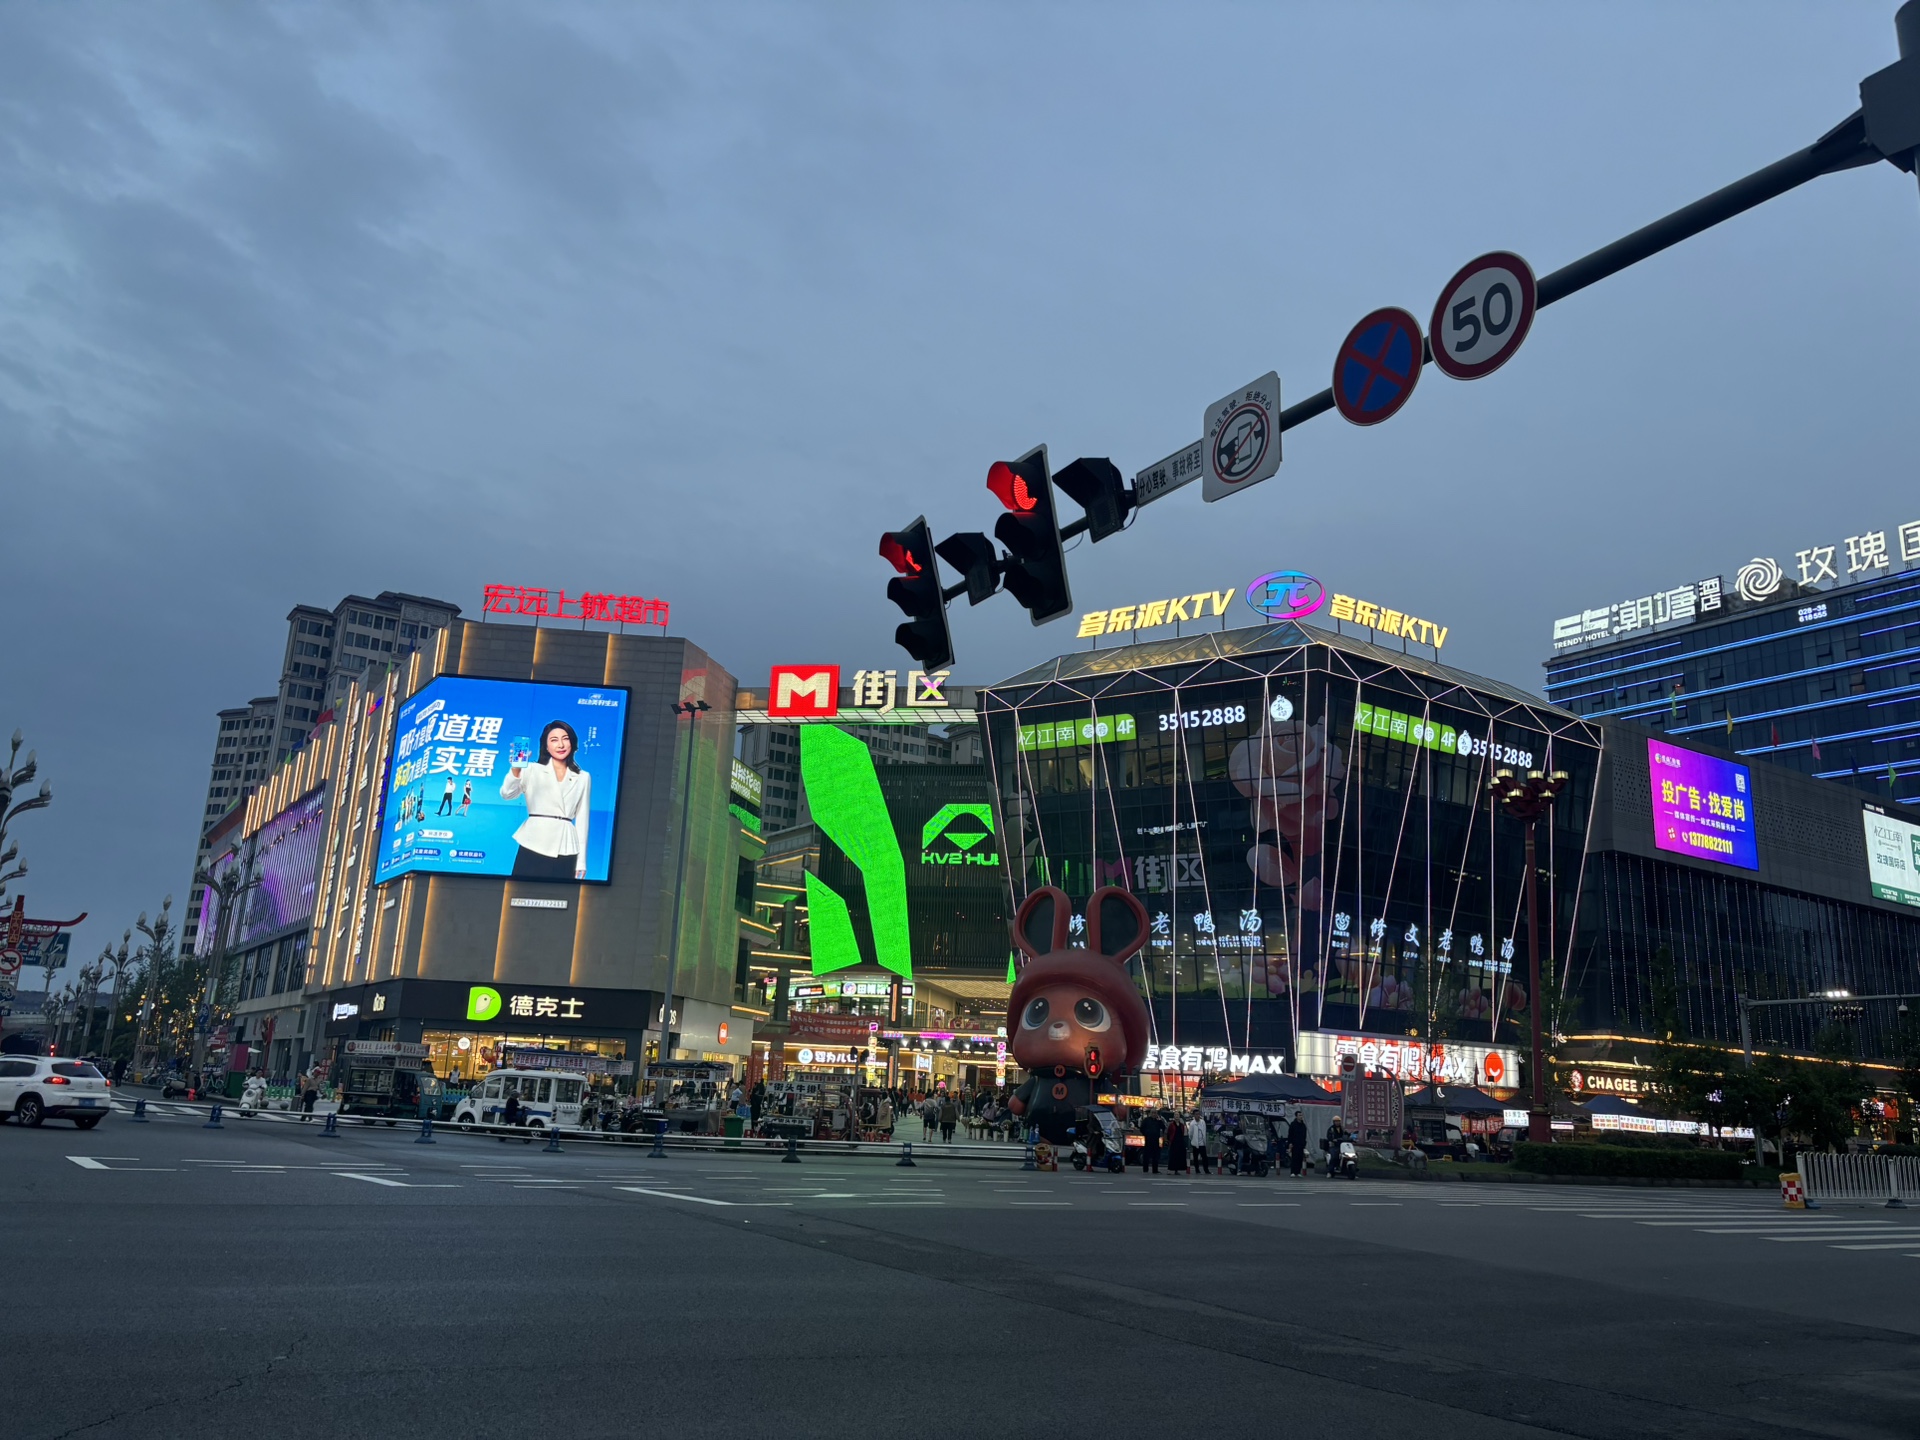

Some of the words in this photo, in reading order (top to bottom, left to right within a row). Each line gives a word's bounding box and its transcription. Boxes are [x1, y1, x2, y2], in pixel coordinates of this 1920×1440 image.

[1452, 282, 1513, 352] 50
[1077, 588, 1236, 638] 音乐派KTV
[1329, 593, 1449, 649] 音乐派KTV
[1799, 611, 1828, 623] 618555
[1553, 637, 1584, 650] TRENDY
[1585, 631, 1611, 641] HOTEL
[853, 669, 951, 715] 街区
[1019, 725, 1076, 746] 忆江南
[1116, 719, 1134, 734] 4F
[1158, 705, 1246, 731] 35152888
[1354, 709, 1408, 736] 忆江南
[1441, 731, 1455, 747] 4F
[1472, 738, 1533, 769] 35152888
[1661, 779, 1746, 822] 投广告·找爱尚
[921, 852, 963, 865] KV2
[1134, 853, 1207, 892] 街区
[509, 995, 585, 1020] 德克士
[1587, 1075, 1638, 1092] CHAGEE
